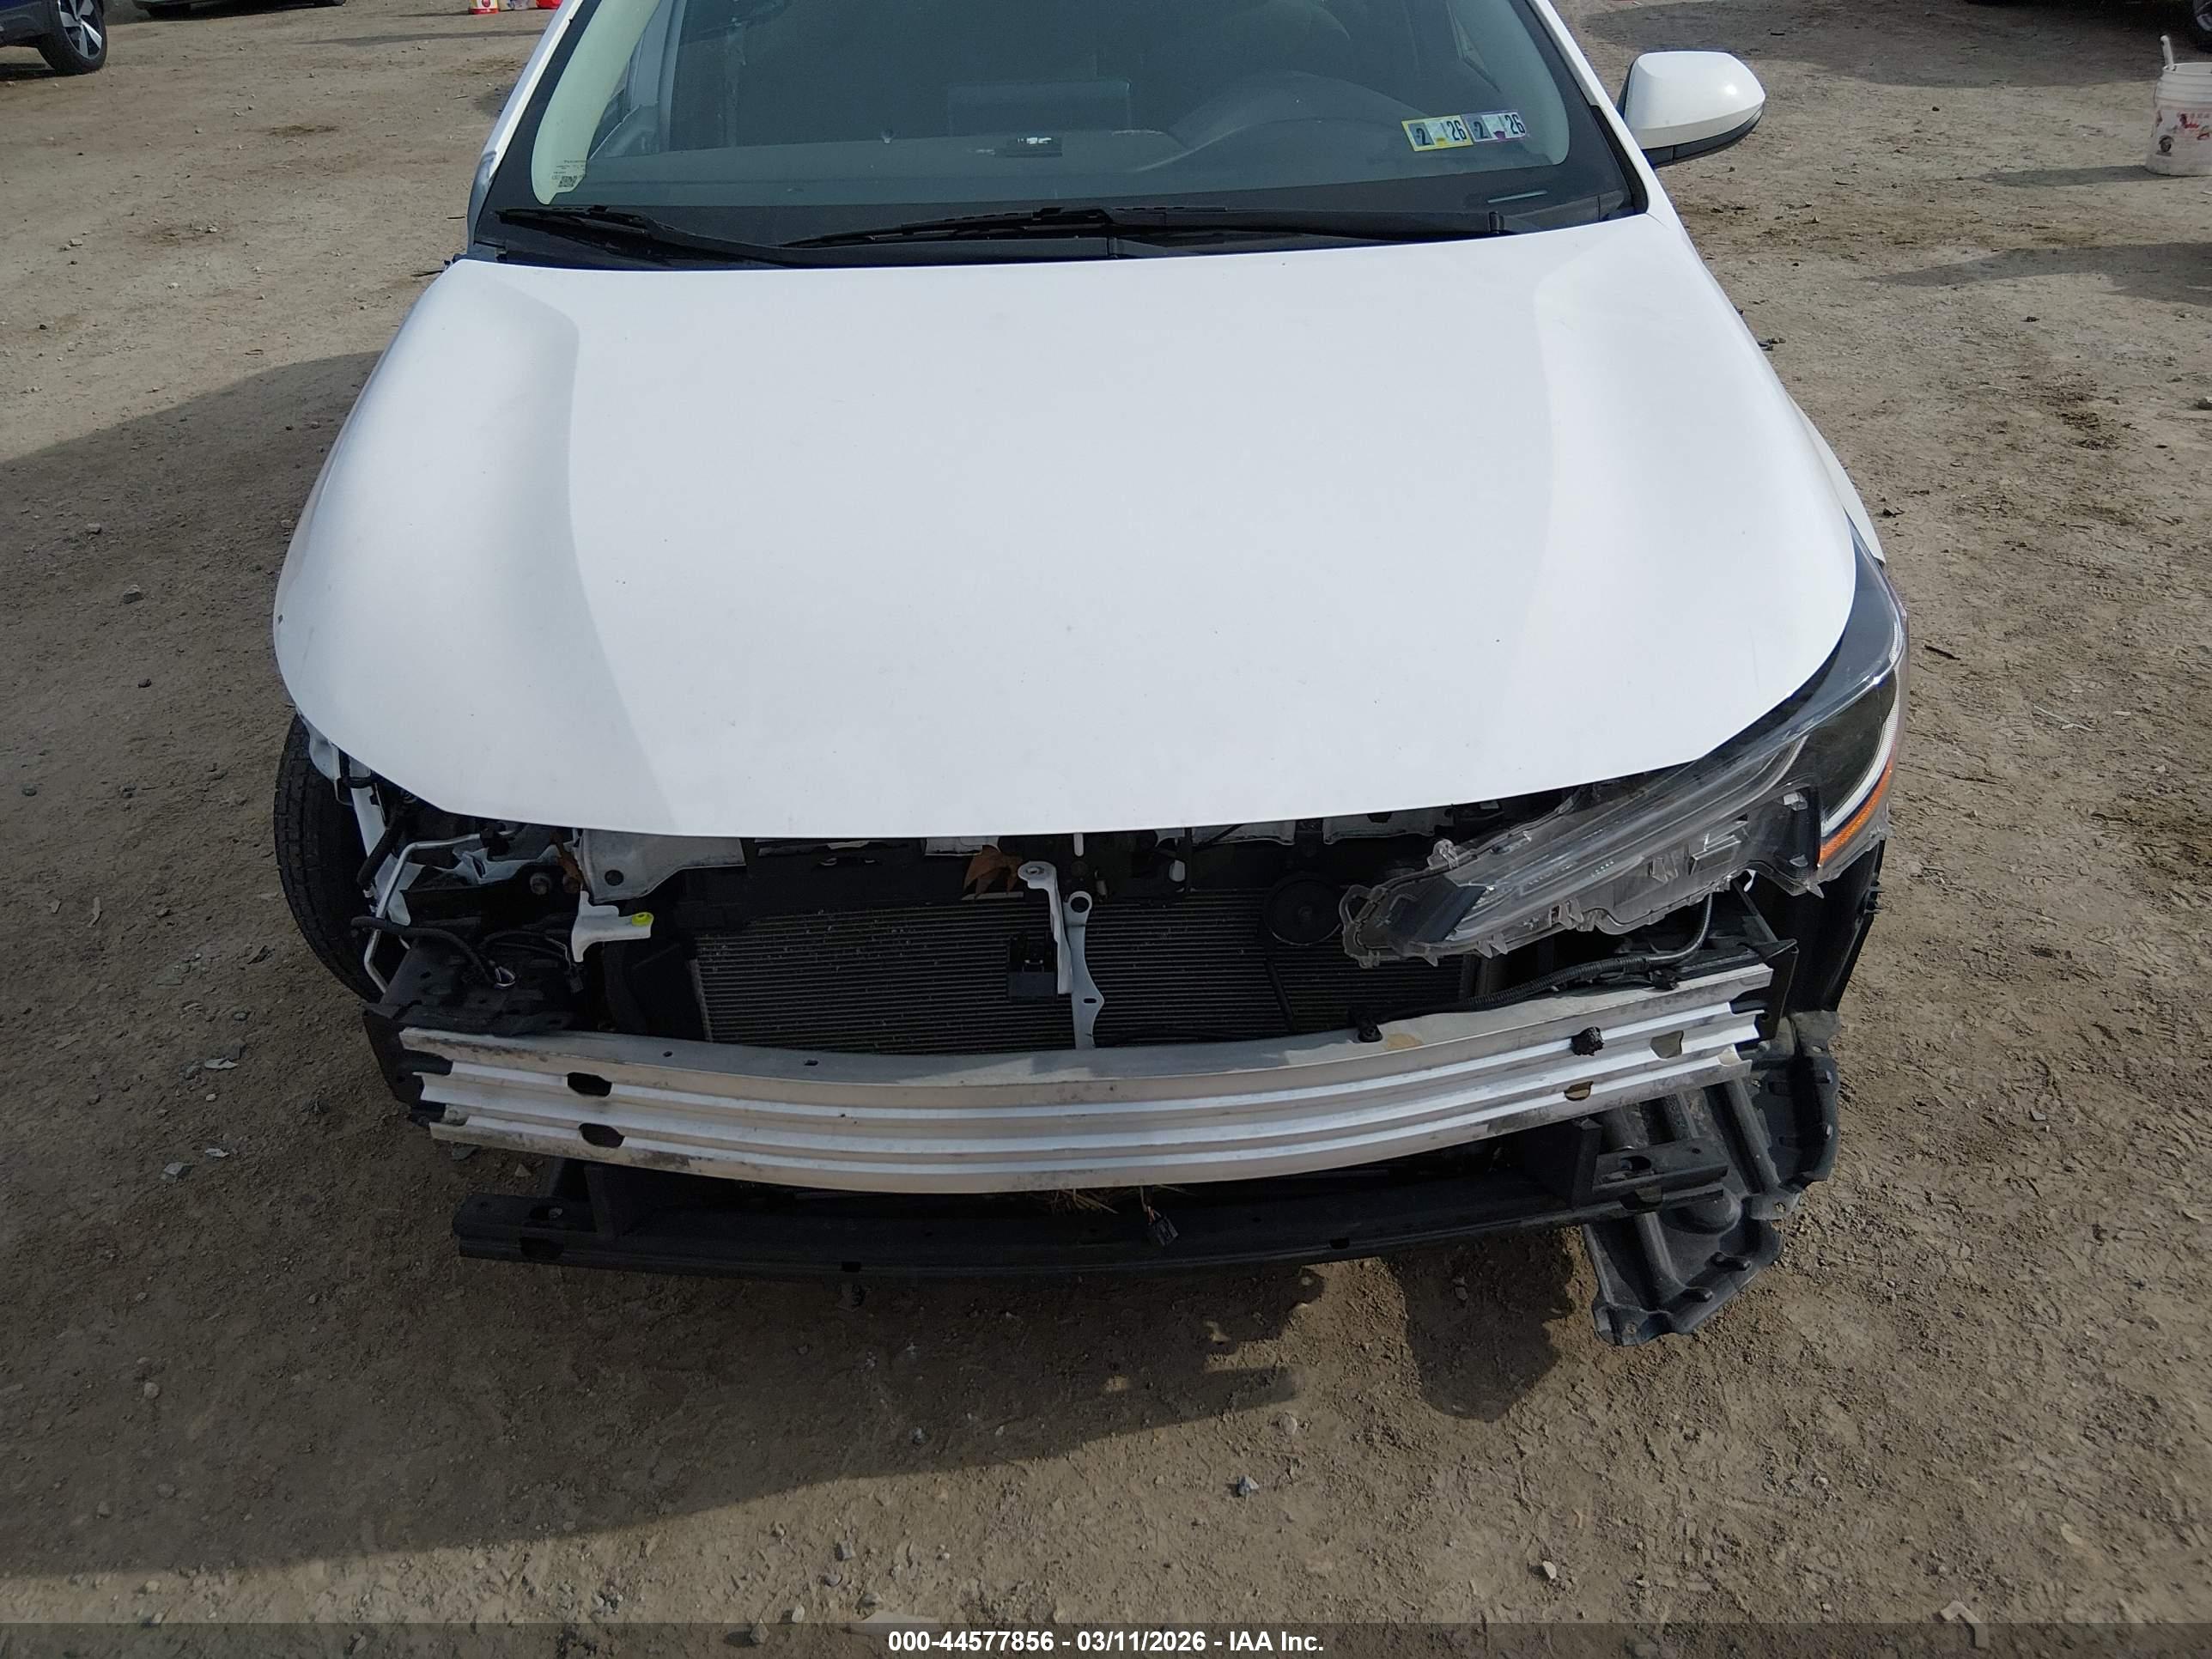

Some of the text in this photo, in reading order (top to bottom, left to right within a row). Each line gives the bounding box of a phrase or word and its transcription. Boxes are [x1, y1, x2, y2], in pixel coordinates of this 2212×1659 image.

[1416, 120, 1467, 145] 2 26
[1474, 113, 1525, 138] 2 26
